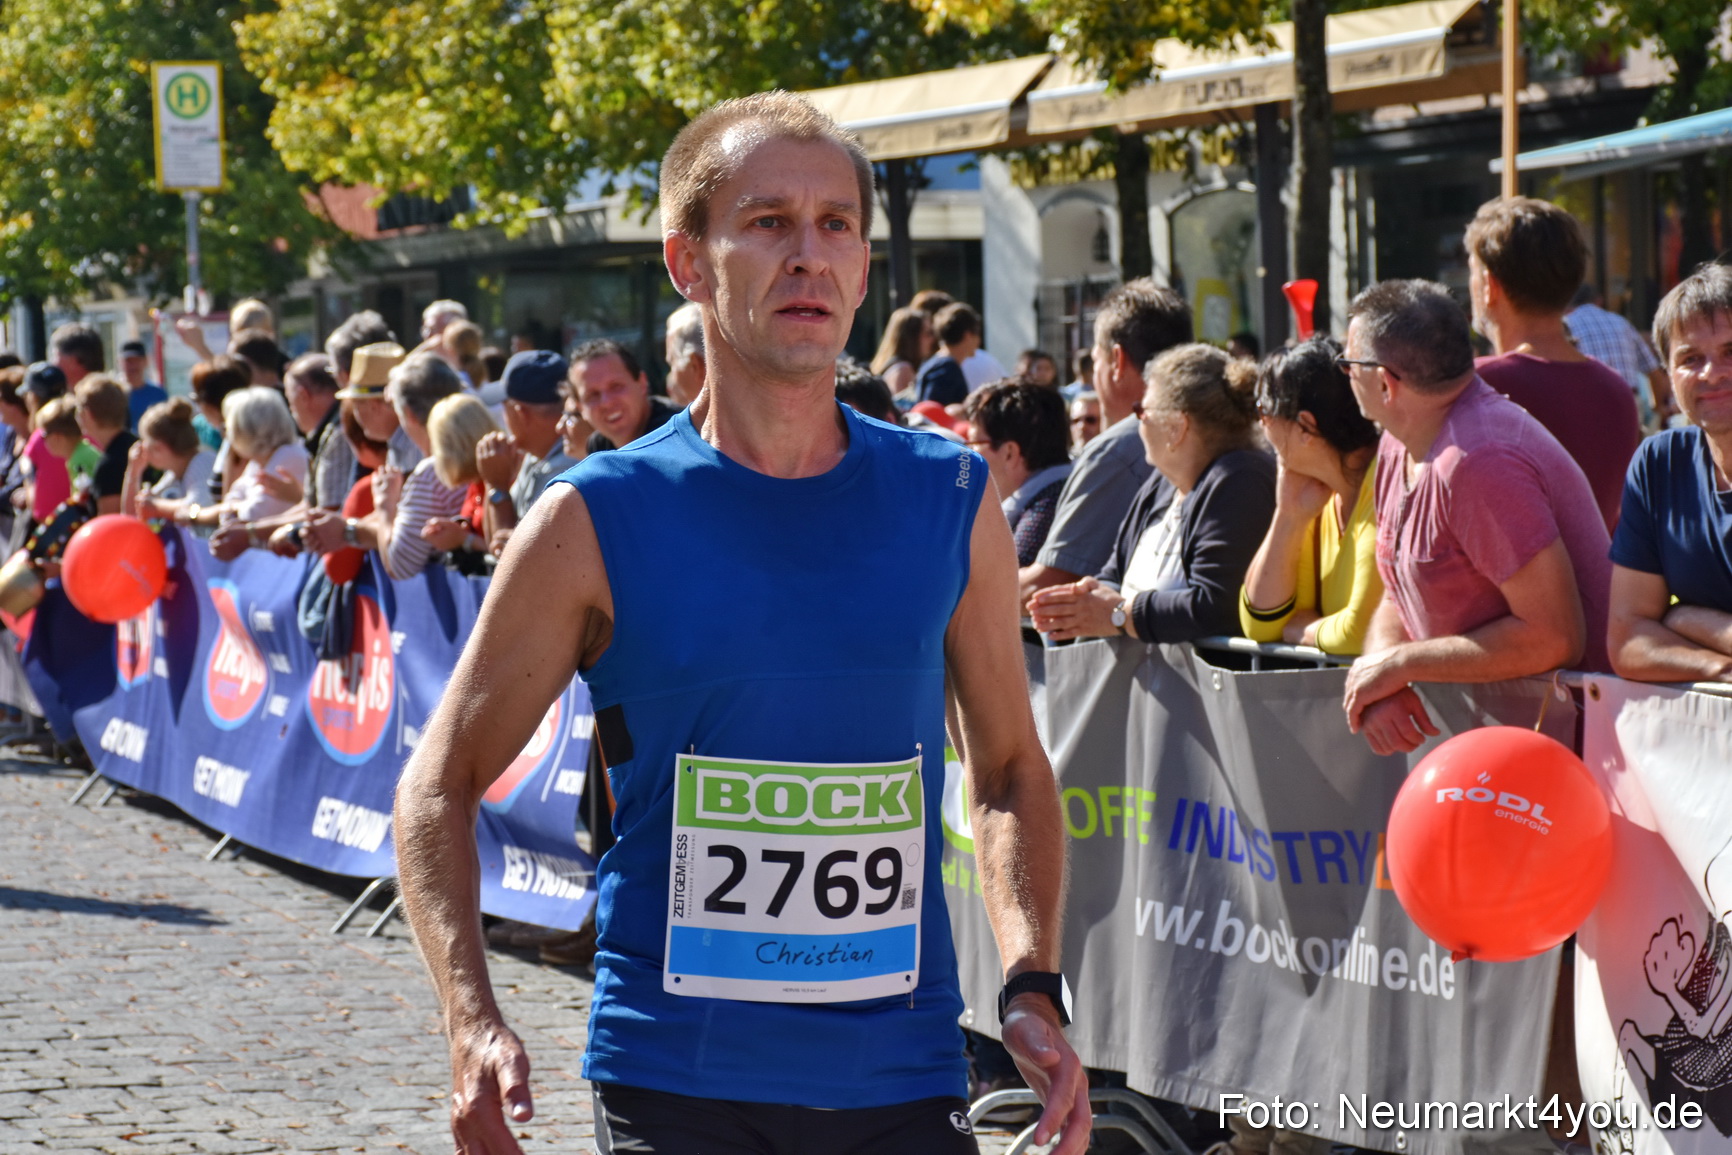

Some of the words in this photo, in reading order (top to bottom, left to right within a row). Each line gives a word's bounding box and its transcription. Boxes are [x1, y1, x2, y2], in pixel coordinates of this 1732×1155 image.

[177, 84, 199, 107] H
[955, 447, 972, 489] Reebo
[698, 771, 911, 825] BOCK
[1494, 808, 1549, 835] energie
[704, 845, 902, 919] 2769
[755, 940, 874, 966] Christian
